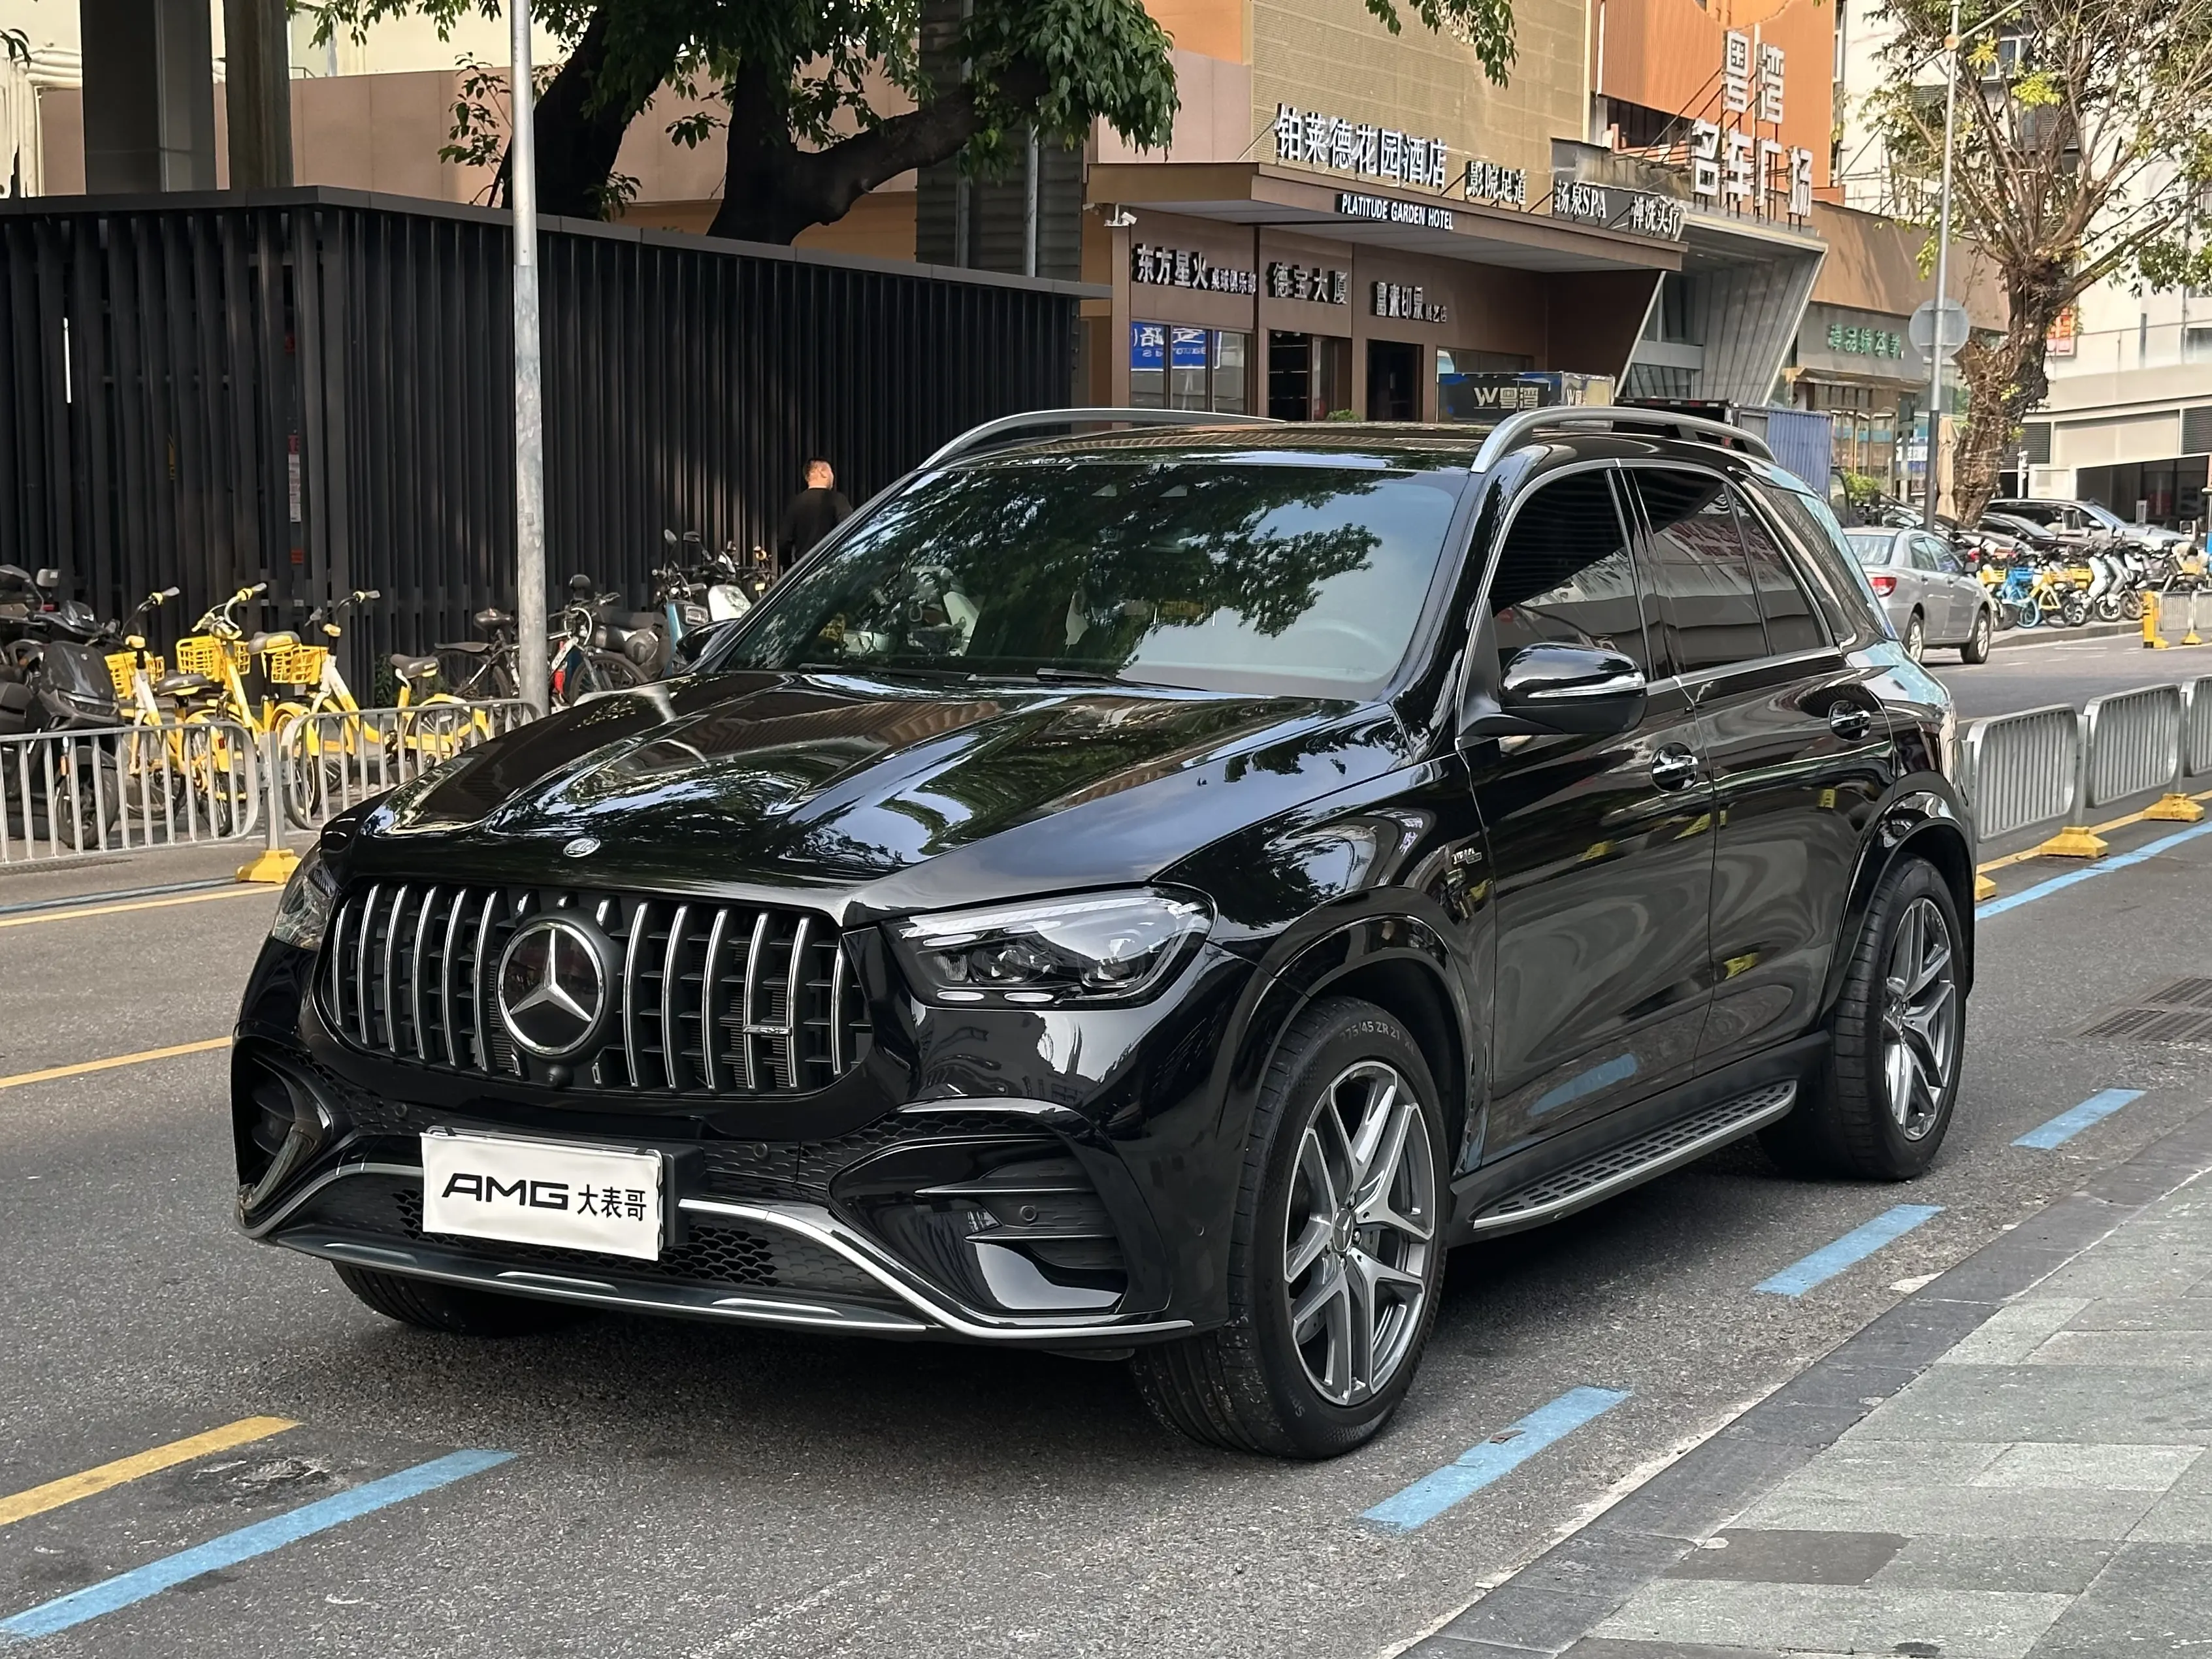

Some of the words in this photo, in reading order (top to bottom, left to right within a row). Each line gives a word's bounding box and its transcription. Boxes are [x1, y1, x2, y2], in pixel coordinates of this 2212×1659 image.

[1275, 103, 1447, 189] 铂莱德花园酒店
[1691, 118, 1813, 217] 名车广场
[1341, 194, 1389, 220] PLATITUDE
[1391, 202, 1425, 225] GARDEN
[1428, 208, 1454, 230] HOTEL
[1555, 180, 1606, 219] 汤泉SPA
[1137, 243, 1209, 289] 东方星火
[1273, 261, 1348, 304] 德宝大厦
[441, 1173, 569, 1210] AMG
[577, 1184, 647, 1221] 大表哥
